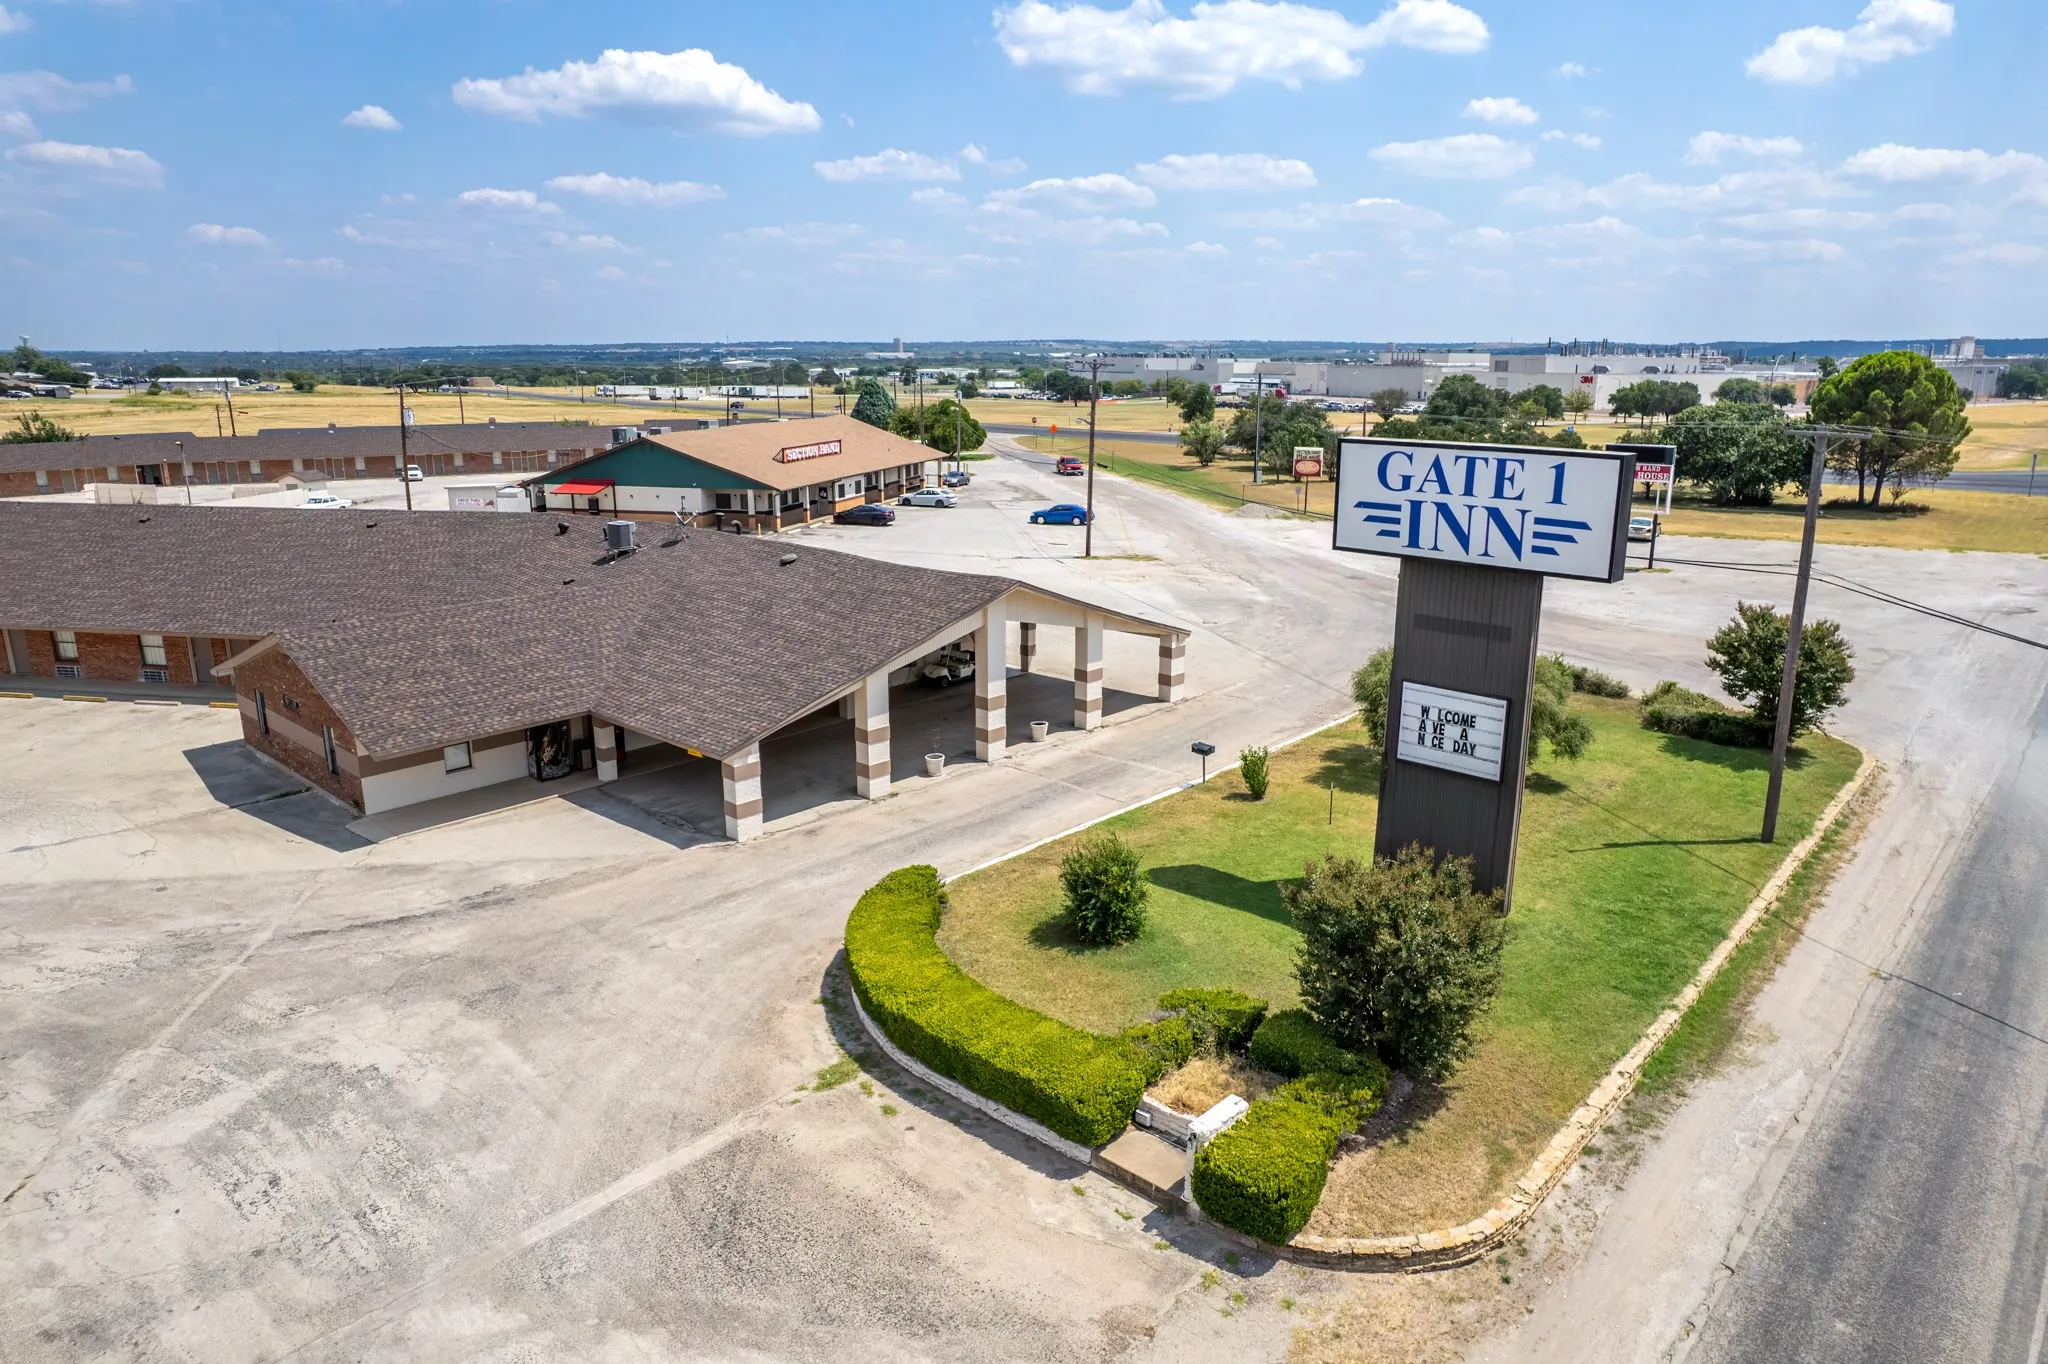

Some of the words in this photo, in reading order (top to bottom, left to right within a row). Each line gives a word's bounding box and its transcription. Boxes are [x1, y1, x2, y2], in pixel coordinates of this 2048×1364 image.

[787, 445, 819, 460] SECTION
[820, 442, 840, 454] HAND
[1377, 451, 1525, 501] GATE
[1546, 461, 1567, 505] 1
[1638, 472, 1669, 480] HOUSE
[1402, 499, 1532, 562] INN
[1453, 740, 1476, 756] DAY
